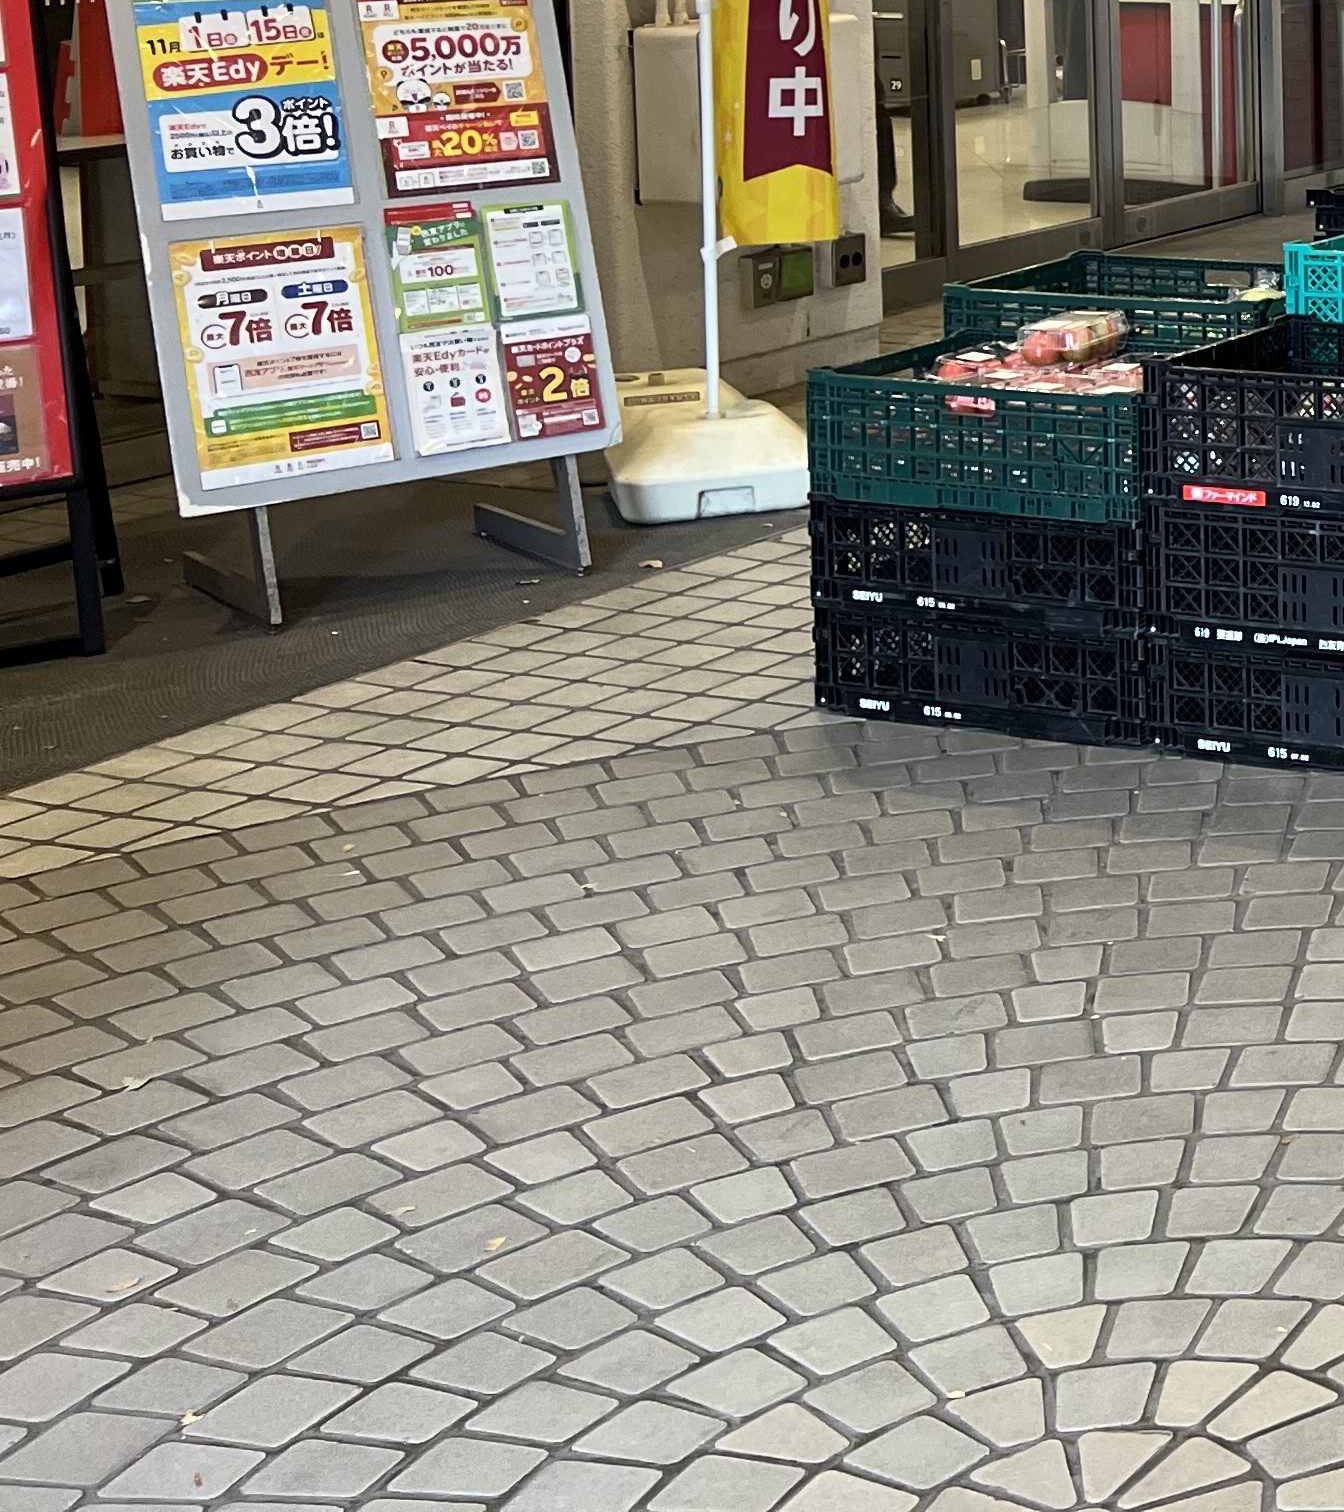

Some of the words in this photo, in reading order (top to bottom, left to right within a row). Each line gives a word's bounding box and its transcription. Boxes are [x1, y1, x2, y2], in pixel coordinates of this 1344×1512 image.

[145, 39, 181, 56] 11月
[410, 32, 522, 62] 5,000万
[159, 60, 261, 88] 楽天Edy
[400, 58, 514, 78] ポイントが当たる!
[281, 97, 330, 112] ポイント
[233, 96, 279, 156] 3
[281, 114, 337, 153] 倍!
[427, 264, 455, 278] 100
[300, 300, 354, 336] 7倍
[218, 310, 273, 347] 7倍
[537, 365, 568, 403] 2
[1280, 494, 1300, 507] 619
[852, 589, 884, 603] SEIYU
[916, 595, 936, 608] 615
[859, 697, 891, 712] SEIYU
[1197, 738, 1231, 753] SEIYU
[1267, 746, 1288, 759] 615
